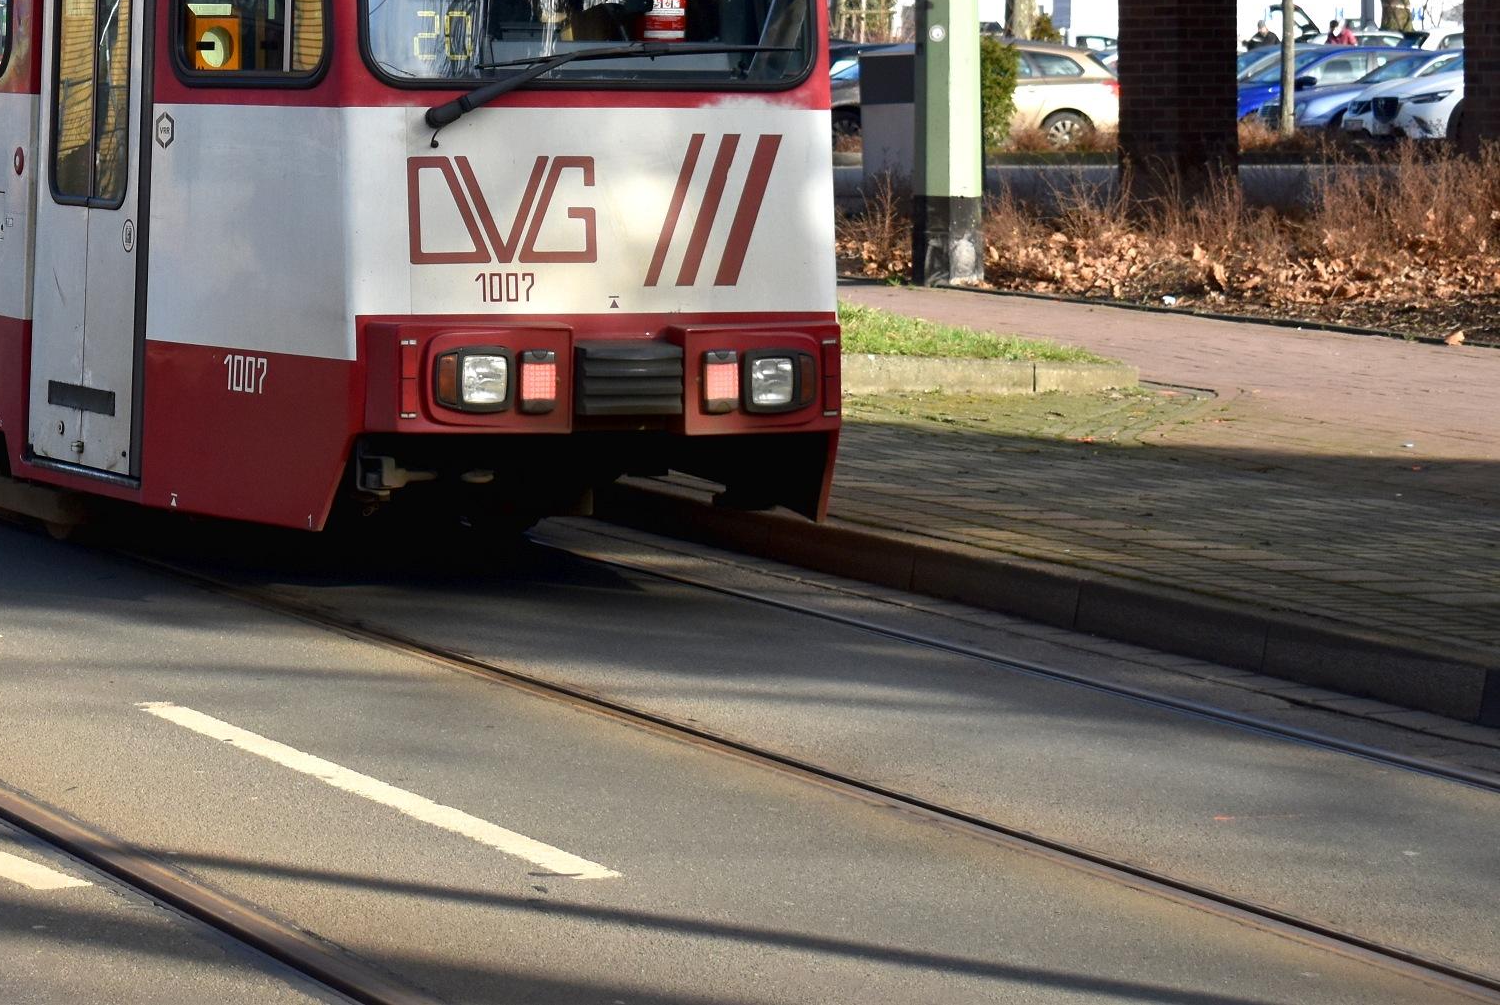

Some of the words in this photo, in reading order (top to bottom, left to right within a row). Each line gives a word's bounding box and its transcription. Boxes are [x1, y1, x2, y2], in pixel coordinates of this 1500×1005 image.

[413, 10, 473, 60] 20
[406, 155, 597, 264] DVG
[474, 272, 535, 303] 1007
[223, 354, 268, 395] 1007
